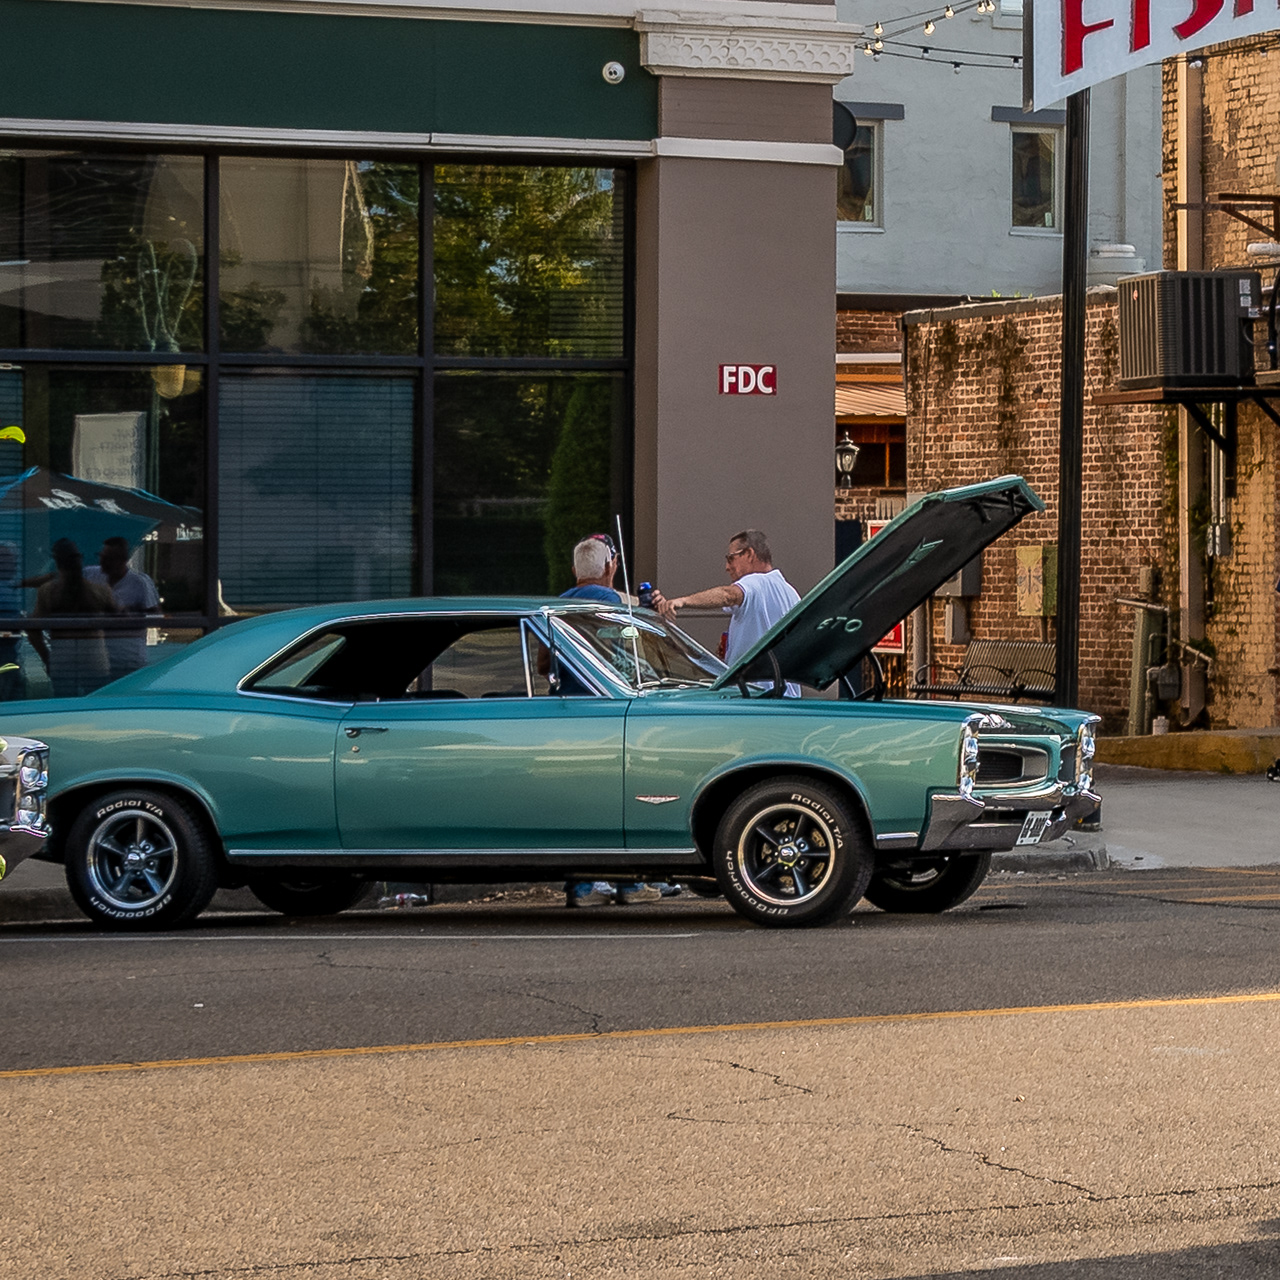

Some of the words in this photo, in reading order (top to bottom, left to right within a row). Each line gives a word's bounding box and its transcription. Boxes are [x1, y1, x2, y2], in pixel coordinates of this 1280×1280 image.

[723, 366, 773, 394] FDC
[97, 800, 142, 818] Radial
[145, 801, 164, 816] T/A
[791, 793, 835, 824] Radial
[833, 825, 844, 849] T/A
[726, 850, 790, 915] BFGoodrich
[90, 894, 172, 918] BFGoodrich
